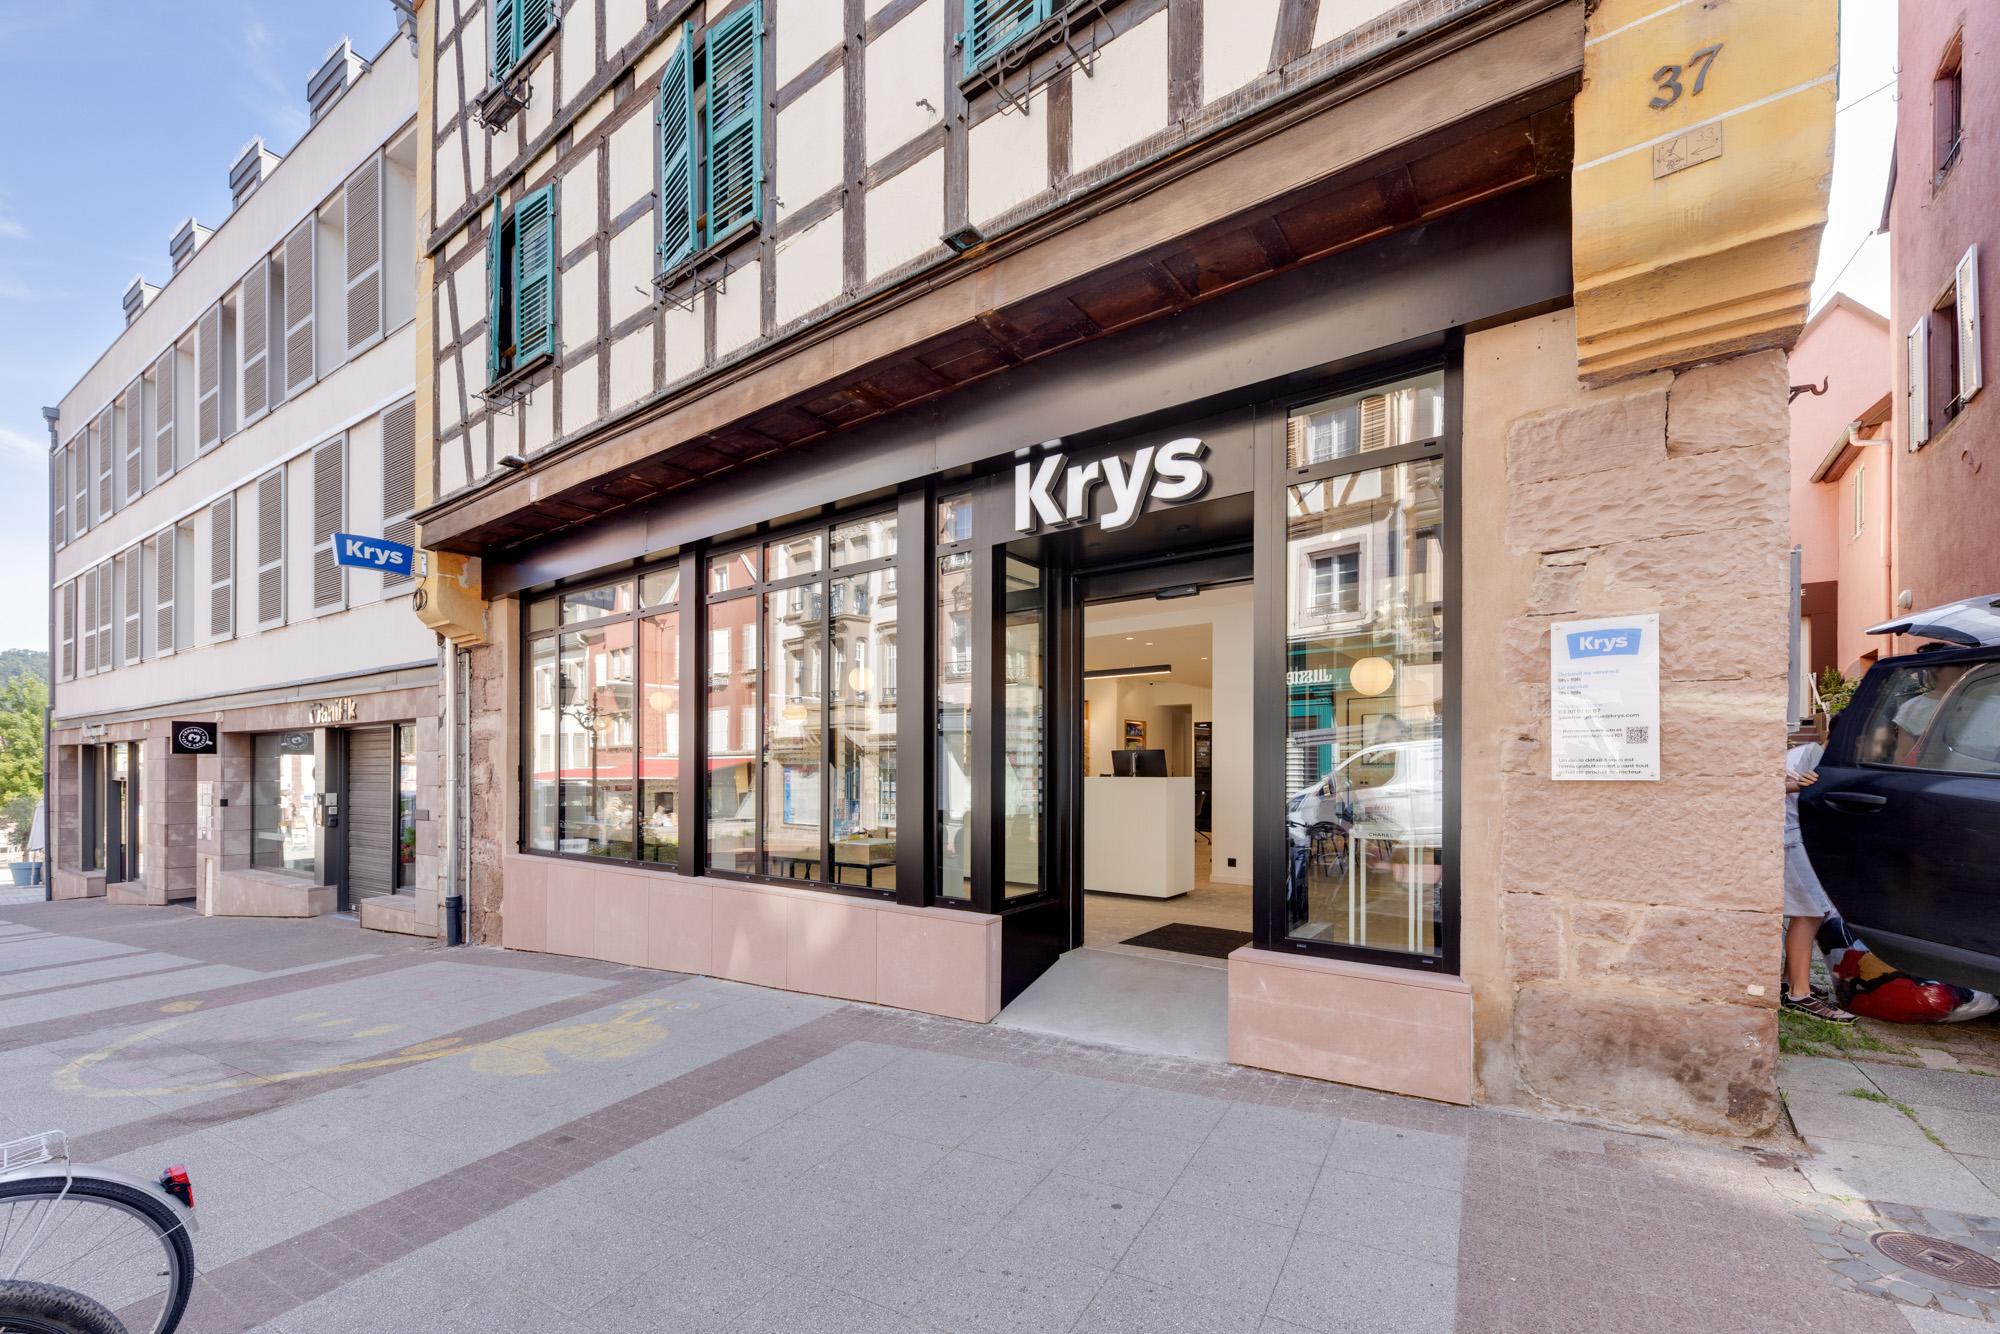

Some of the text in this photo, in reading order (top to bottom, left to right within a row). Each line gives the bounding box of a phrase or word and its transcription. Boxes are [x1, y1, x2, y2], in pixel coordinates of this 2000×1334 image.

[1648, 42, 1724, 111] 37
[1015, 437, 1211, 533] Krys
[346, 539, 404, 565] Krys
[1579, 635, 1628, 652] Krys
